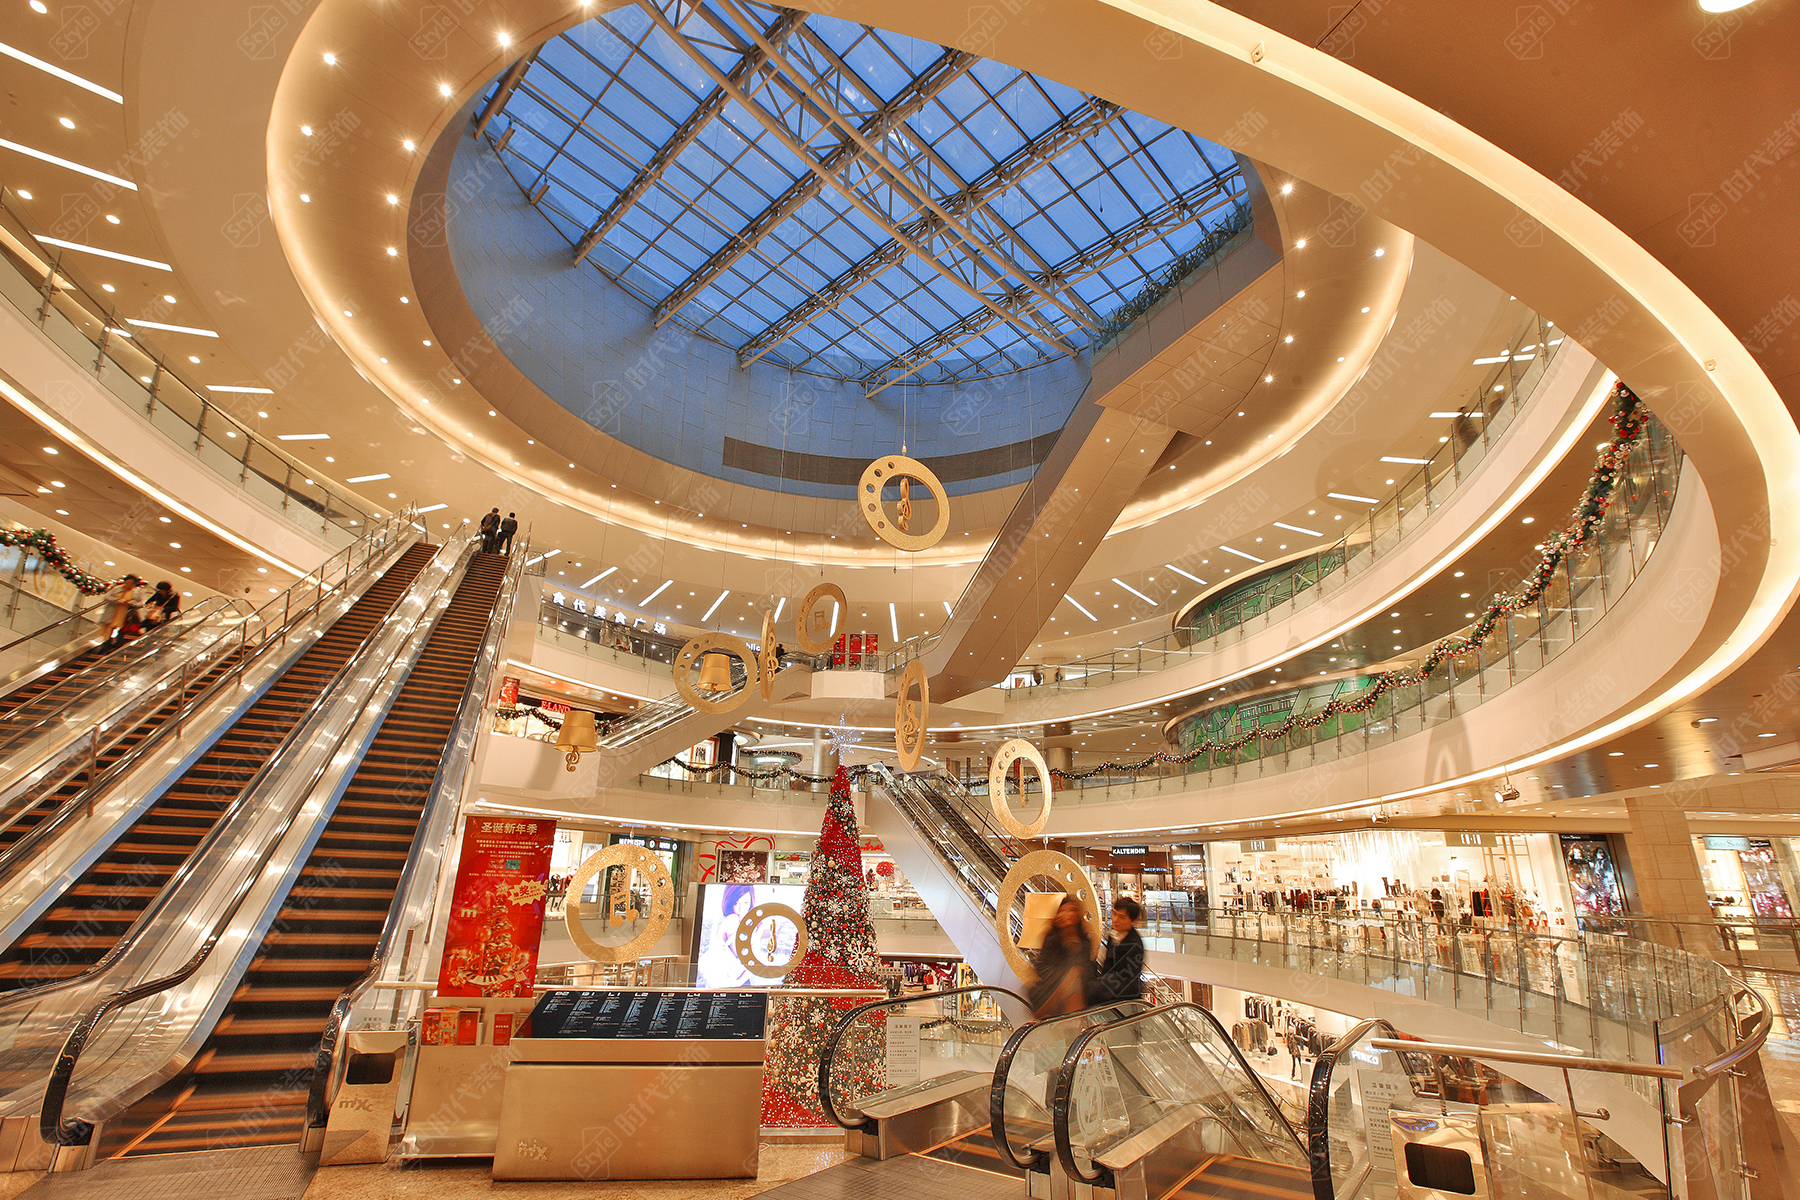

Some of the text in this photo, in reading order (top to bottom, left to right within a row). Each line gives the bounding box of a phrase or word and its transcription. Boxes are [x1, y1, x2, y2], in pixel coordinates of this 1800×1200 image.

[481, 822, 538, 834] 圣诞新年季
